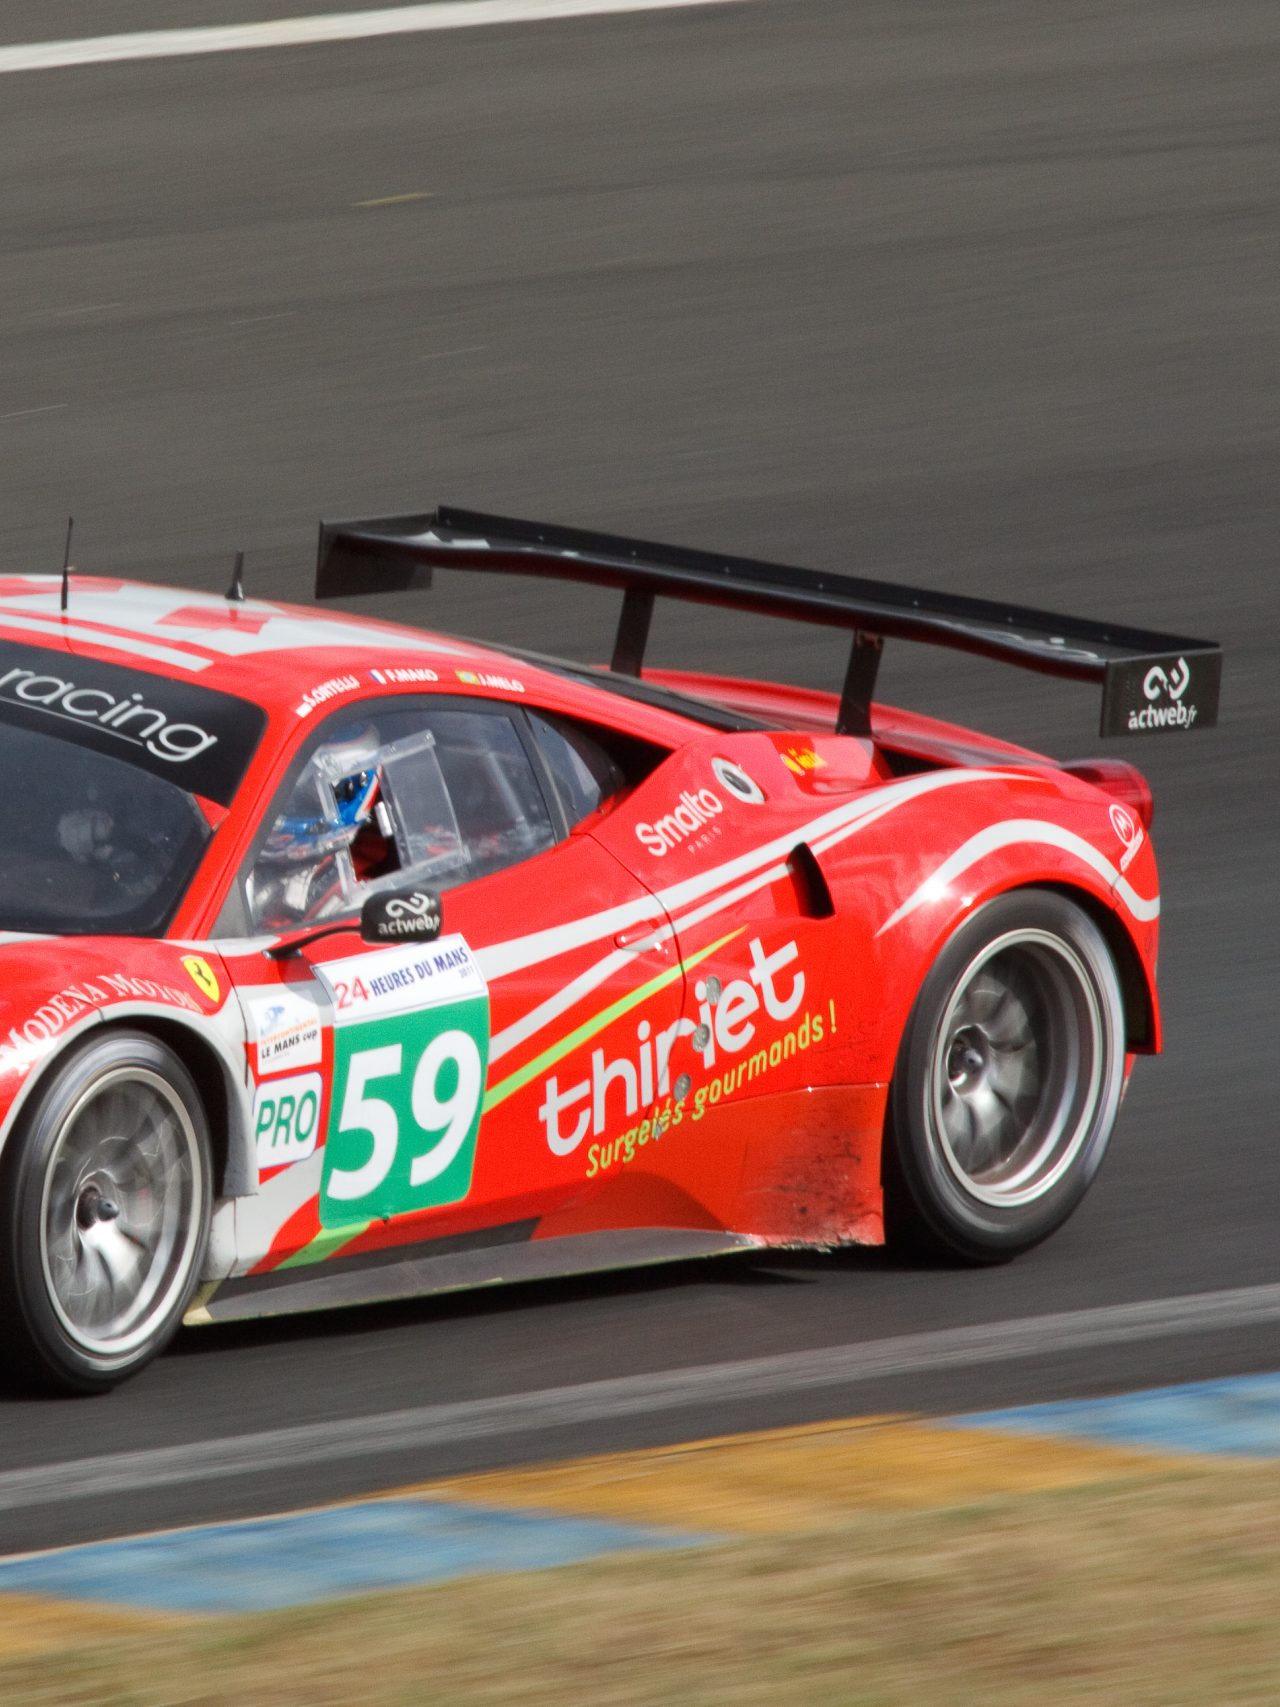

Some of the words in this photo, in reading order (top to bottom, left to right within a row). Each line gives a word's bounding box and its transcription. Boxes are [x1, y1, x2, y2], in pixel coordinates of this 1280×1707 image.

[635, 788, 723, 857] Smalto
[333, 975, 369, 1010] 24
[370, 966, 415, 997] HEURES
[414, 960, 433, 979] DU
[433, 947, 469, 973] MANS
[261, 1046, 270, 1059] LE
[274, 1034, 300, 1053] MANS
[691, 1011, 824, 1121] gourmands
[256, 1090, 318, 1147] PRO
[327, 1030, 481, 1200] 59
